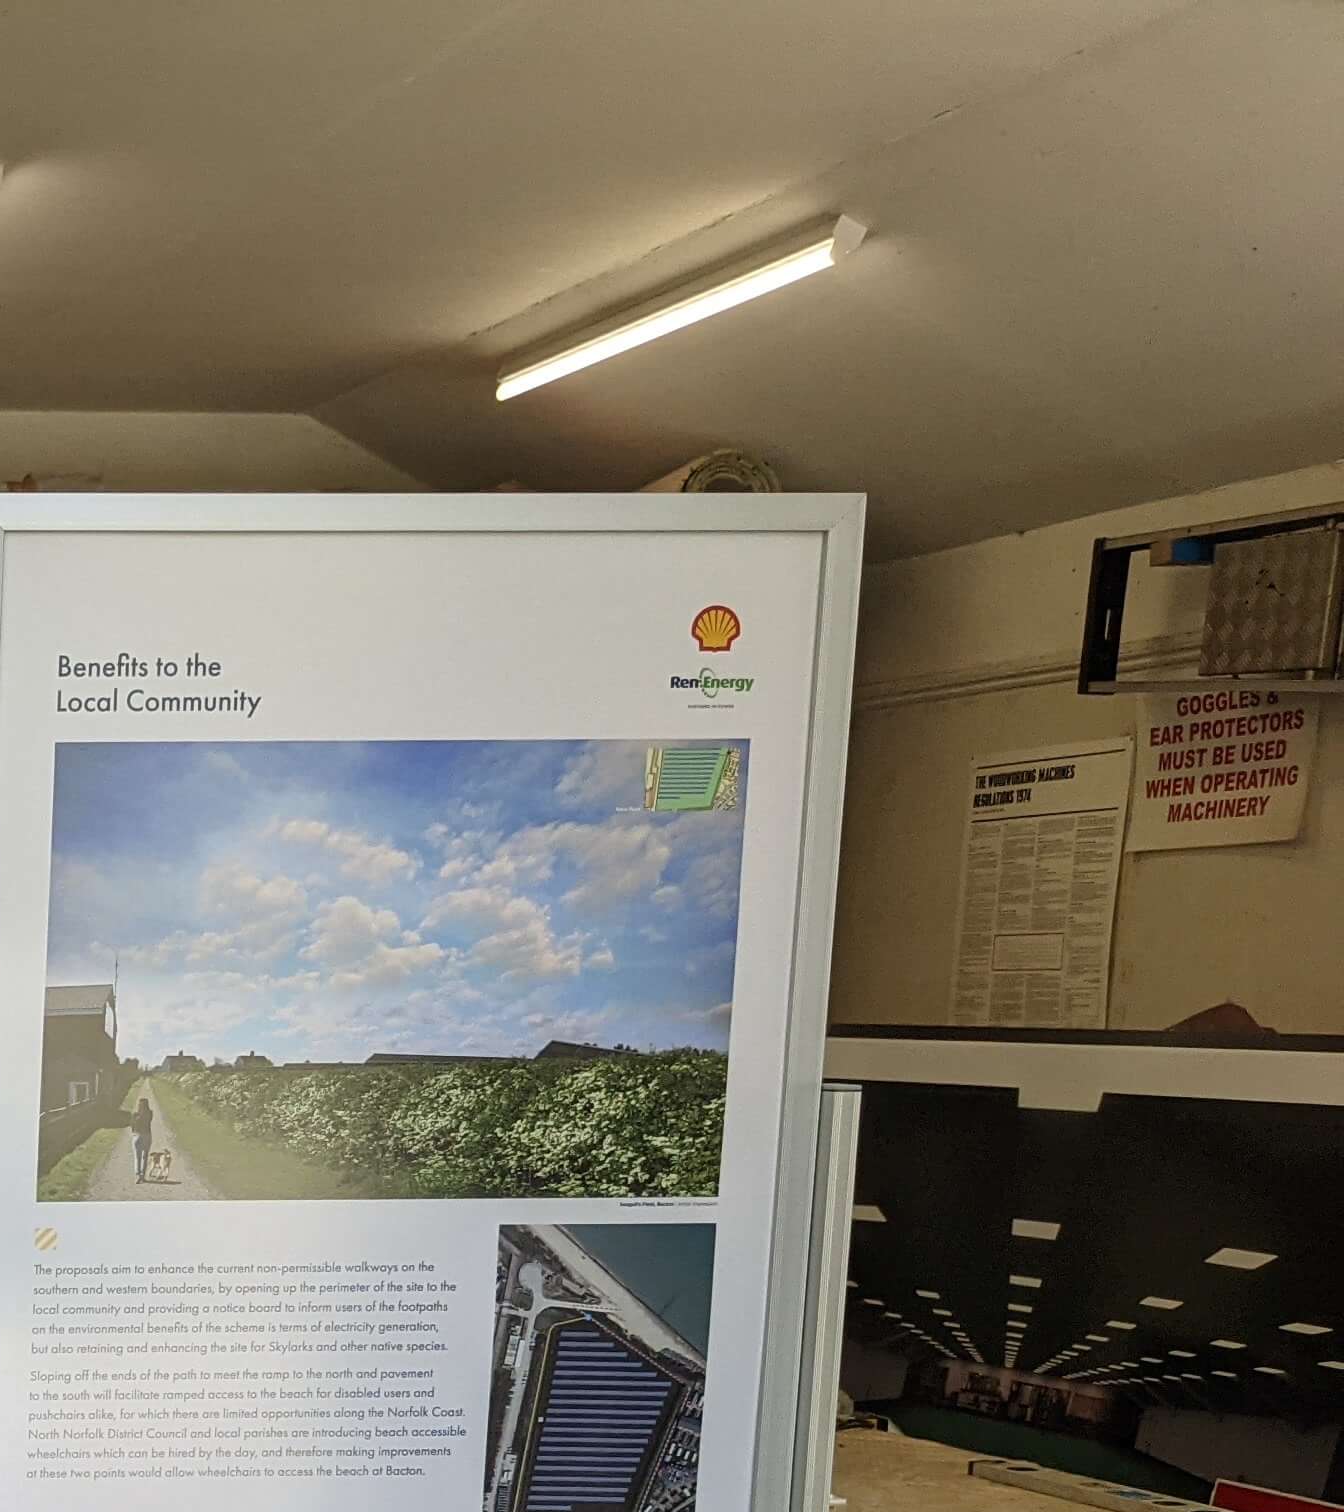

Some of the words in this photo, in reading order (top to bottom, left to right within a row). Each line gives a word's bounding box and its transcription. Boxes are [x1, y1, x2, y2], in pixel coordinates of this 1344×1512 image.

[58, 652, 149, 678] Benefits
[155, 657, 179, 678] to
[185, 652, 222, 678] the
[56, 686, 118, 713] Local
[126, 688, 262, 719] Community
[1177, 691, 1261, 717] GOGGLES
[1150, 725, 1184, 747] EAR
[1190, 709, 1305, 742] PROTECTORS
[1158, 748, 1208, 772] MUST
[1212, 745, 1235, 766] BE
[1241, 739, 1287, 763] USED
[1145, 775, 1195, 799] WHEN
[1200, 765, 1299, 793] OPERATING
[1167, 795, 1271, 823] MACHINERY
[33, 1263, 53, 1276] The
[55, 1263, 109, 1280] proposals
[111, 1264, 132, 1275] aim
[134, 1265, 145, 1275] to
[147, 1262, 195, 1274] enhance
[197, 1262, 214, 1275] the
[216, 1264, 255, 1274] current
[256, 1260, 342, 1276] non-permissible
[344, 1260, 399, 1277] walkways
[400, 1263, 416, 1273] on
[418, 1259, 436, 1273] the
[32, 1302, 60, 1315] local
[62, 1303, 121, 1318] community
[123, 1302, 145, 1315] and
[147, 1301, 200, 1318] providing
[201, 1305, 210, 1314] a
[212, 1302, 246, 1313] notice
[248, 1300, 283, 1313] board
[284, 1303, 296, 1313] to
[297, 1300, 332, 1313] inform
[334, 1304, 363, 1314] users
[364, 1299, 377, 1313] of
[378, 1298, 396, 1312] the
[397, 1298, 449, 1315] footpaths
[28, 1427, 60, 1441] North
[62, 1427, 105, 1441] Norfolk
[107, 1427, 144, 1439] District
[145, 1426, 188, 1439] Council
[189, 1426, 212, 1439] and
[213, 1426, 241, 1439] local
[243, 1426, 289, 1441] parishes
[291, 1429, 310, 1438] are
[311, 1425, 373, 1441] introducing
[373, 1424, 409, 1441] beach
[410, 1424, 468, 1438] accessible
